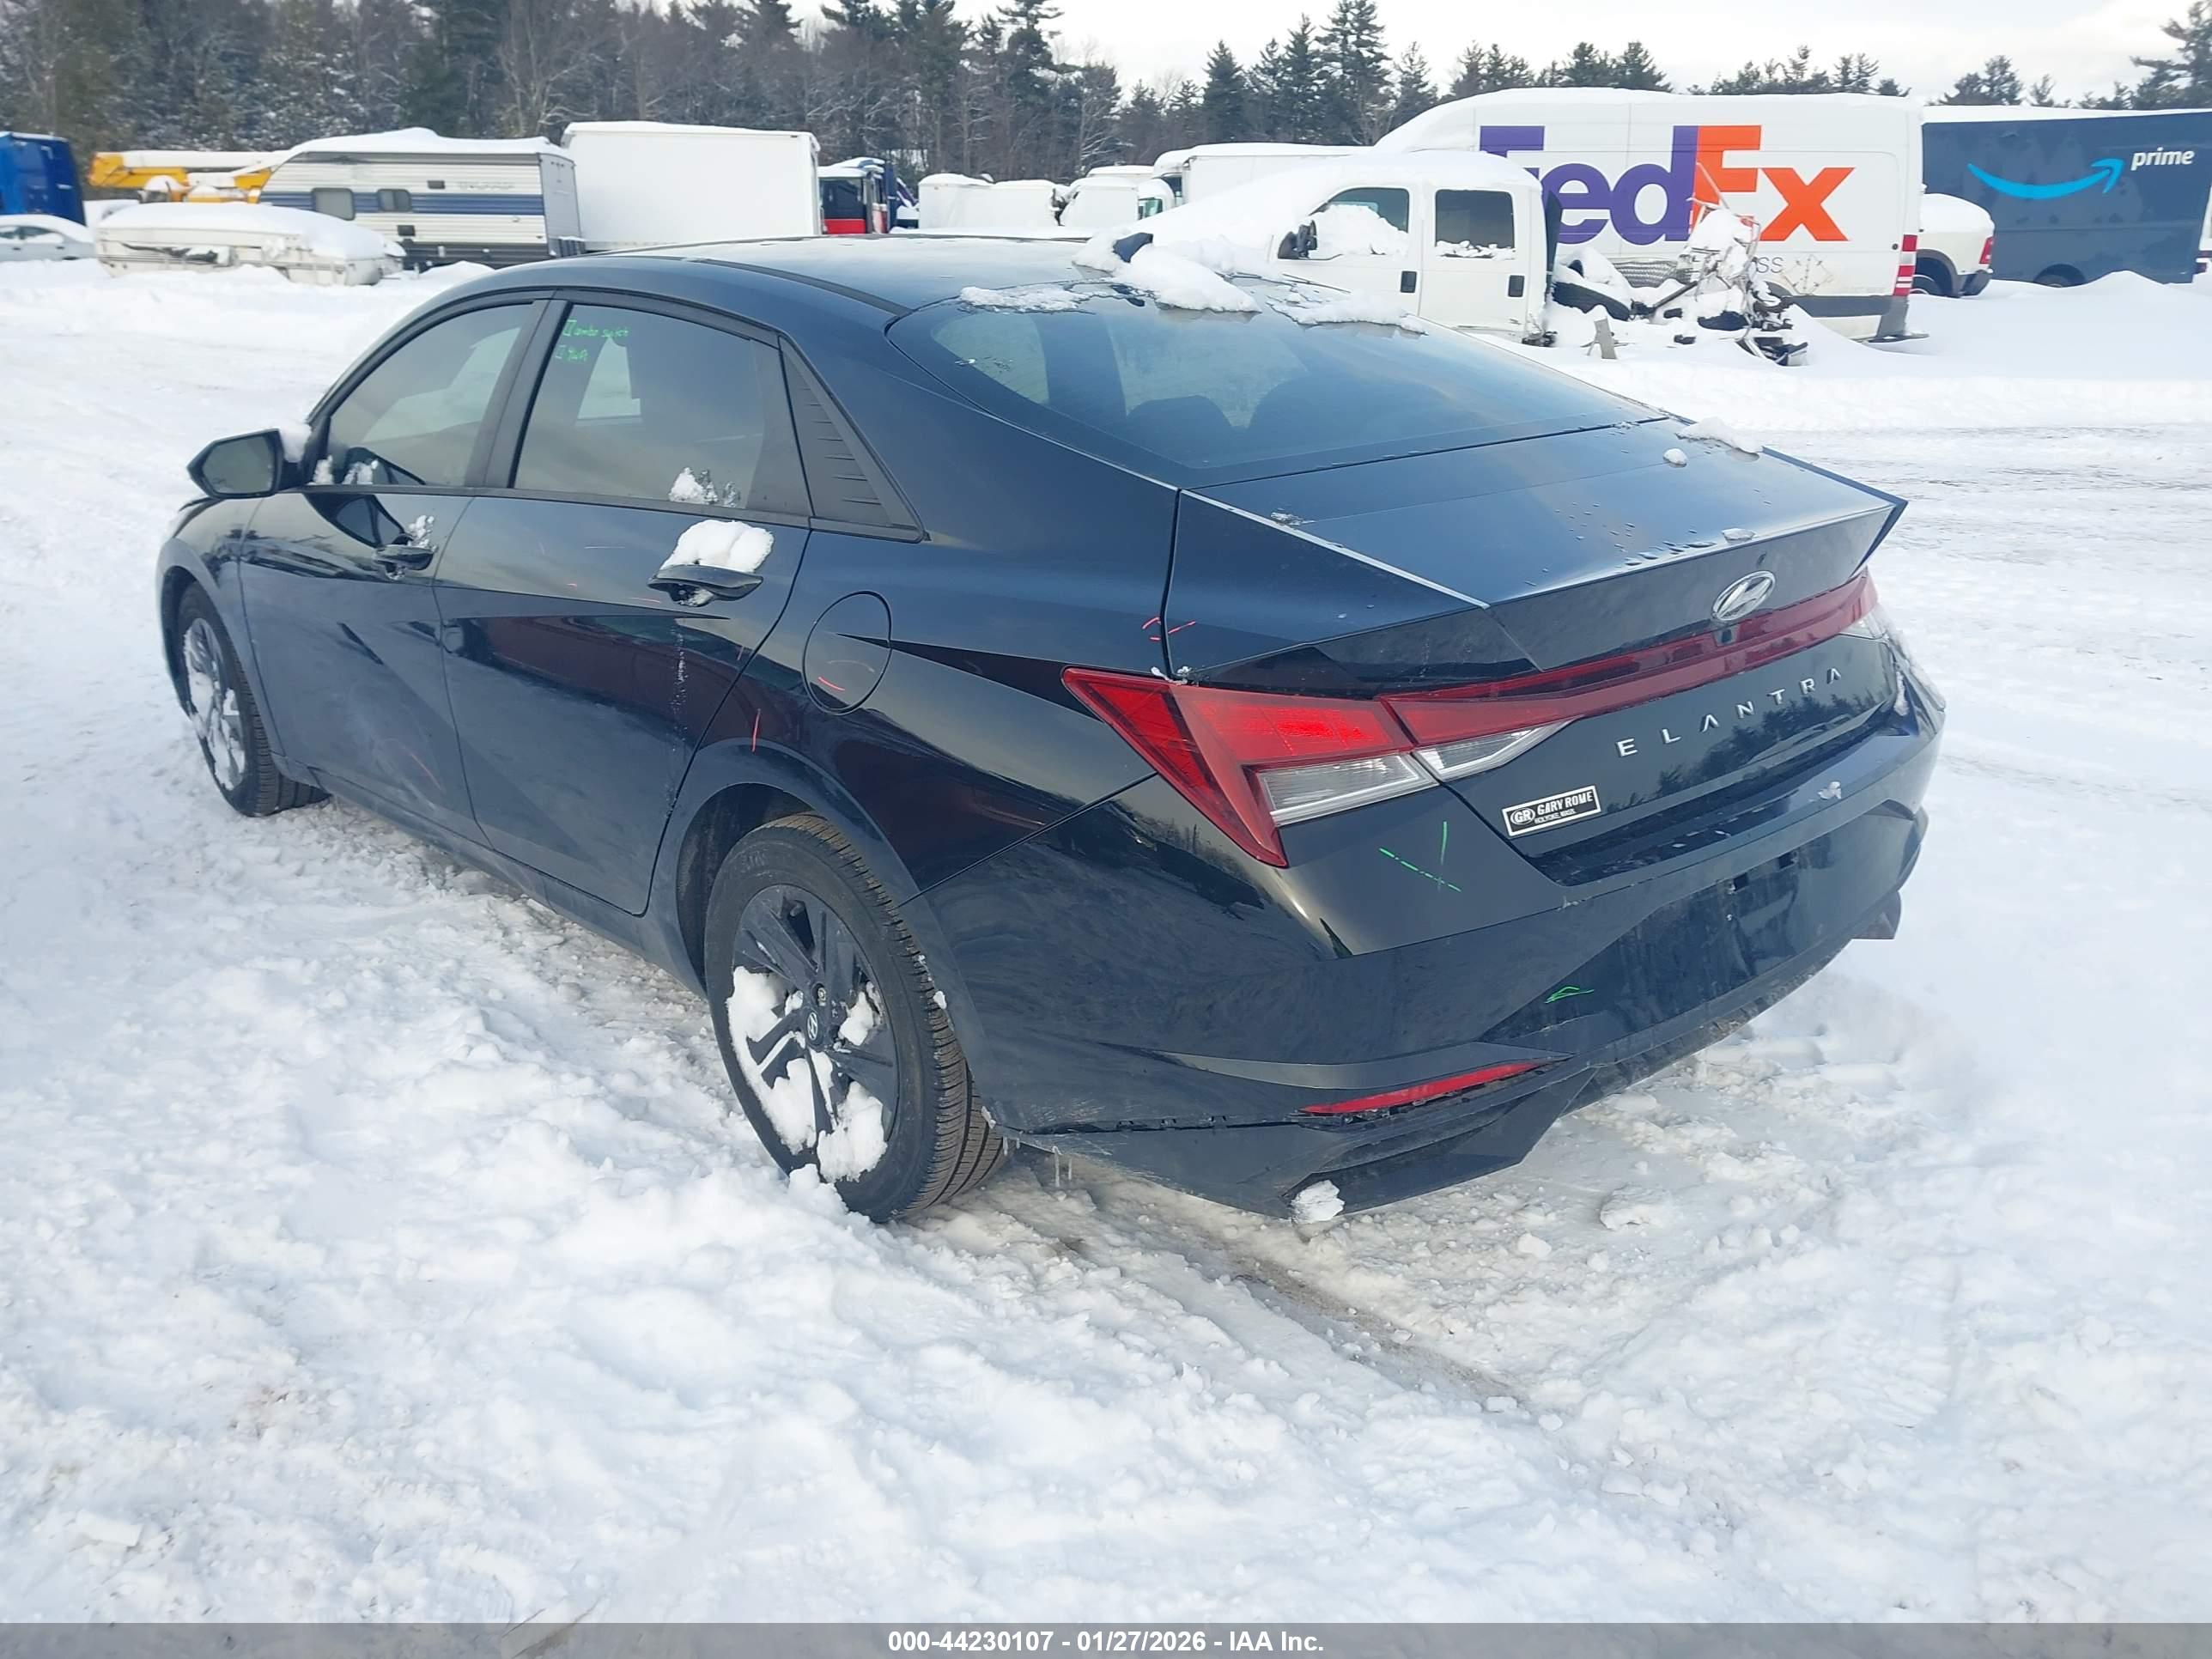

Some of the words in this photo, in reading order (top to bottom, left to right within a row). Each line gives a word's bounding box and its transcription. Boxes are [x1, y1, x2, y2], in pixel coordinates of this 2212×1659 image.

[2130, 146, 2196, 171] prime
[1615, 666, 1843, 759] ELANTRA
[1514, 809, 1531, 823] GR
[1537, 799, 1564, 816] GARY
[1565, 791, 1594, 808] ROME
